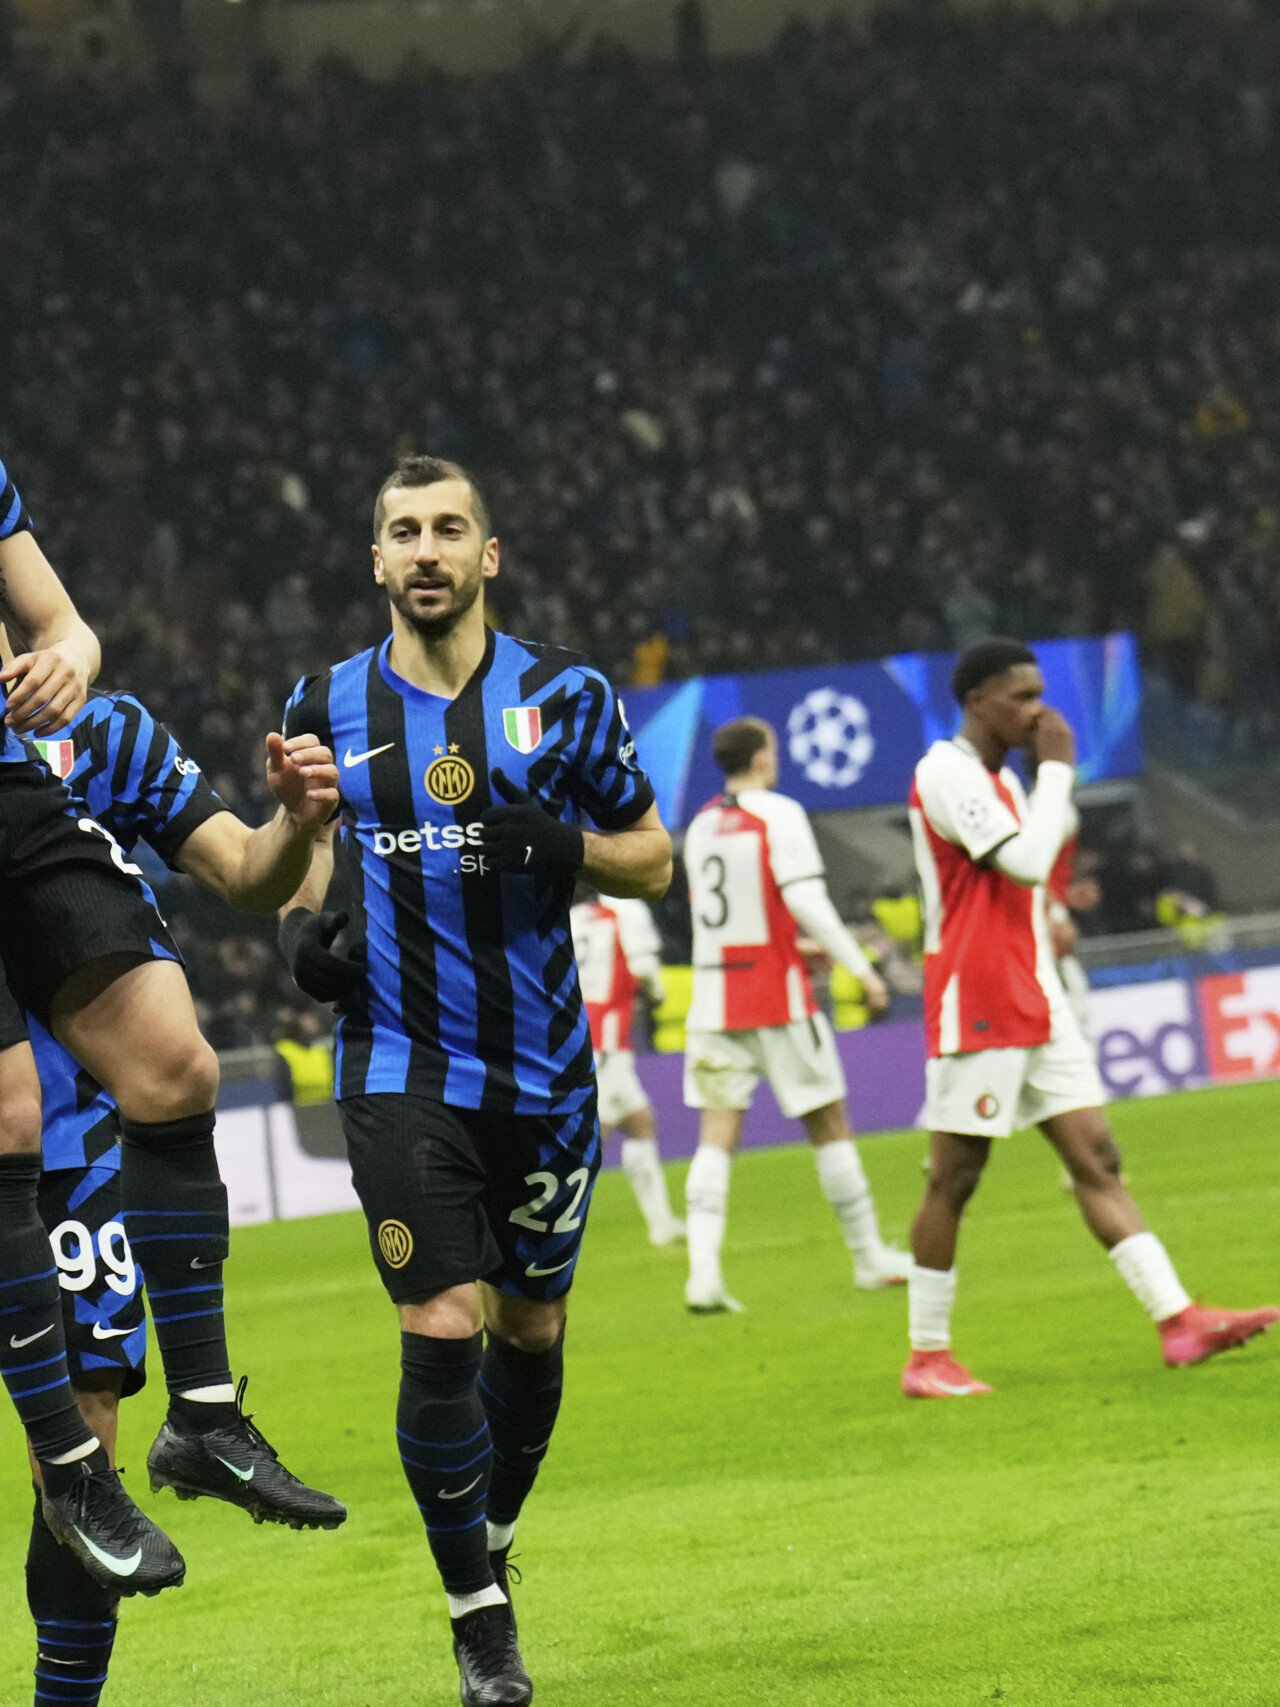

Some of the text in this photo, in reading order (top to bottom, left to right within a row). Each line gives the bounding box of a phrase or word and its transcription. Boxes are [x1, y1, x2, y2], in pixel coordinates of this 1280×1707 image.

[701, 854, 729, 930] 3
[508, 1167, 589, 1234] 22
[48, 1219, 136, 1296] 99
